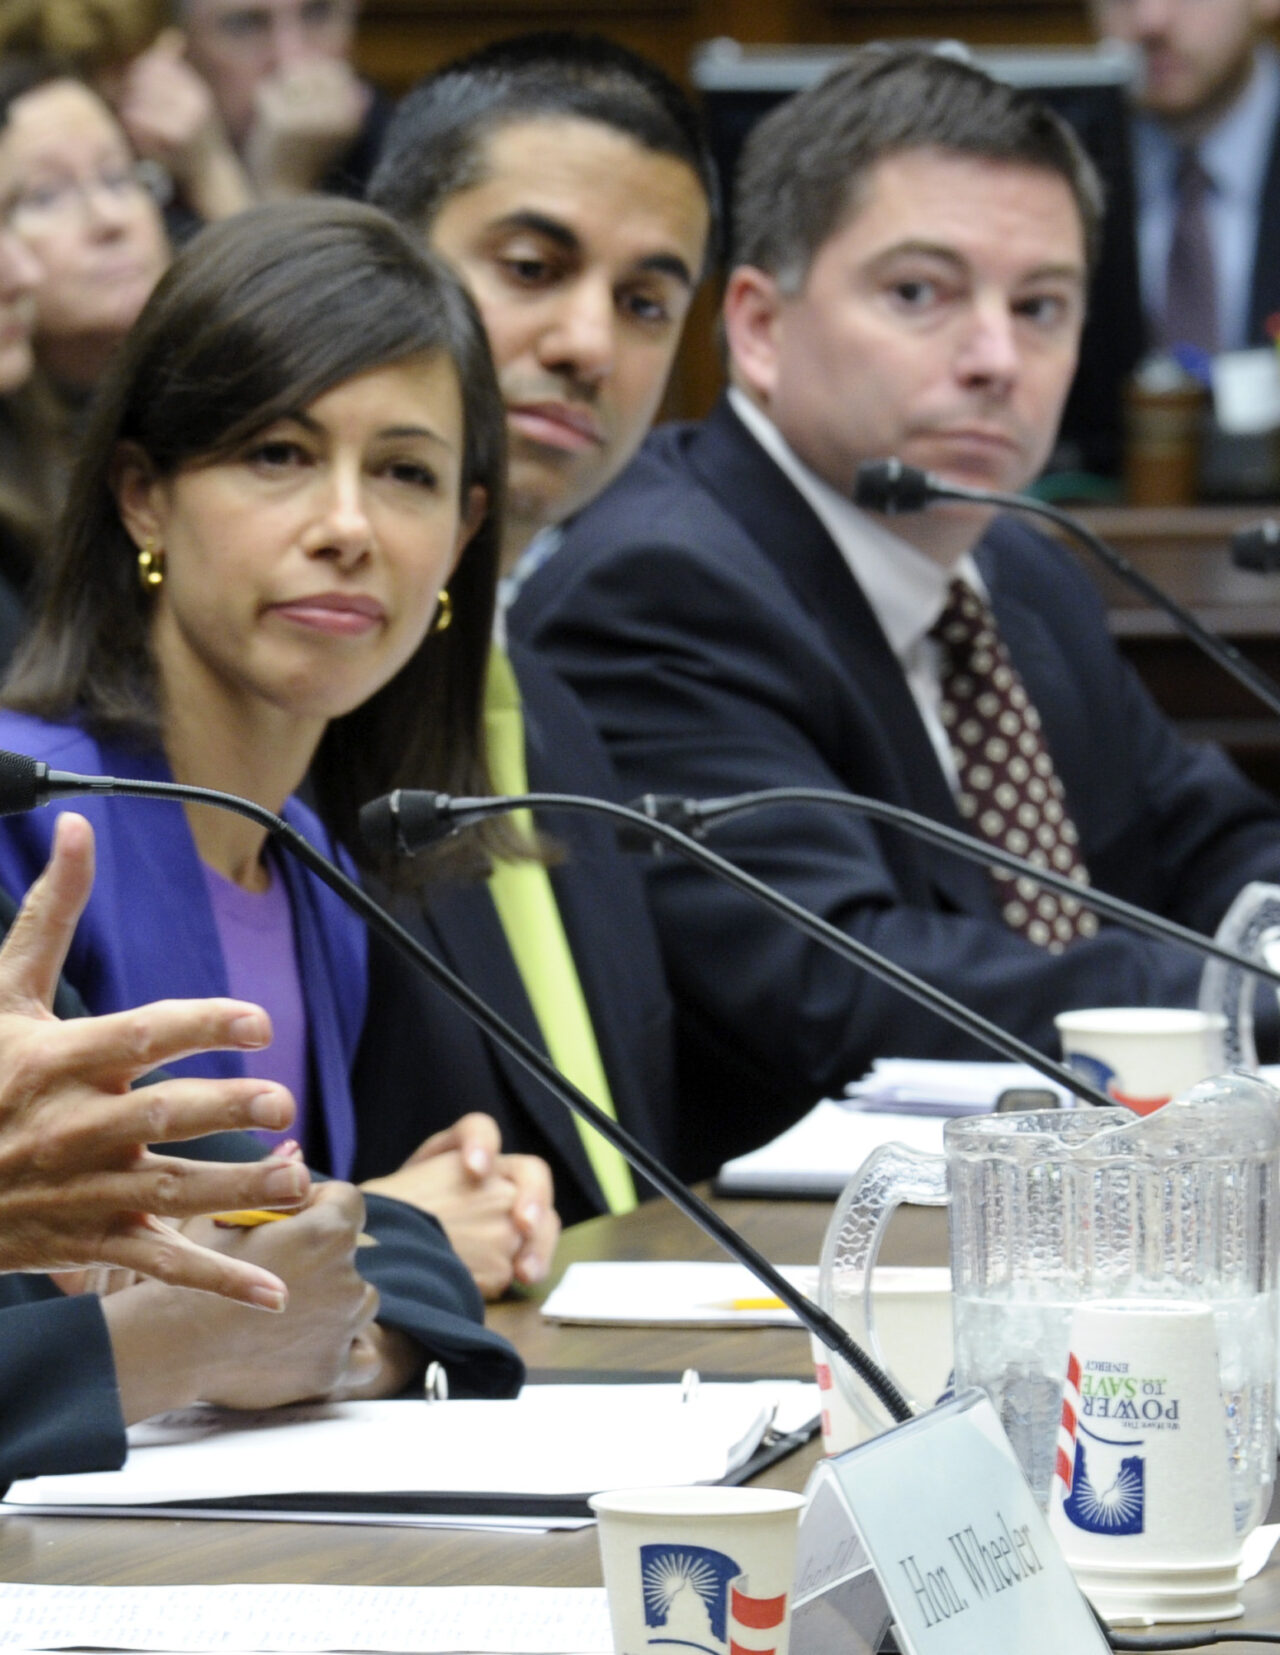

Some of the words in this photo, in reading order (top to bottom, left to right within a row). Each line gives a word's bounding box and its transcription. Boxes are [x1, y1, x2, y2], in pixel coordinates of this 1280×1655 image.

[1085, 1360, 1129, 1373] ENERGY
[1082, 1374, 1137, 1398] SAVE
[1142, 1383, 1165, 1395] TO
[1082, 1396, 1179, 1420] POWER
[899, 1555, 969, 1628] Hon.
[948, 1511, 1045, 1600] Wheeler
